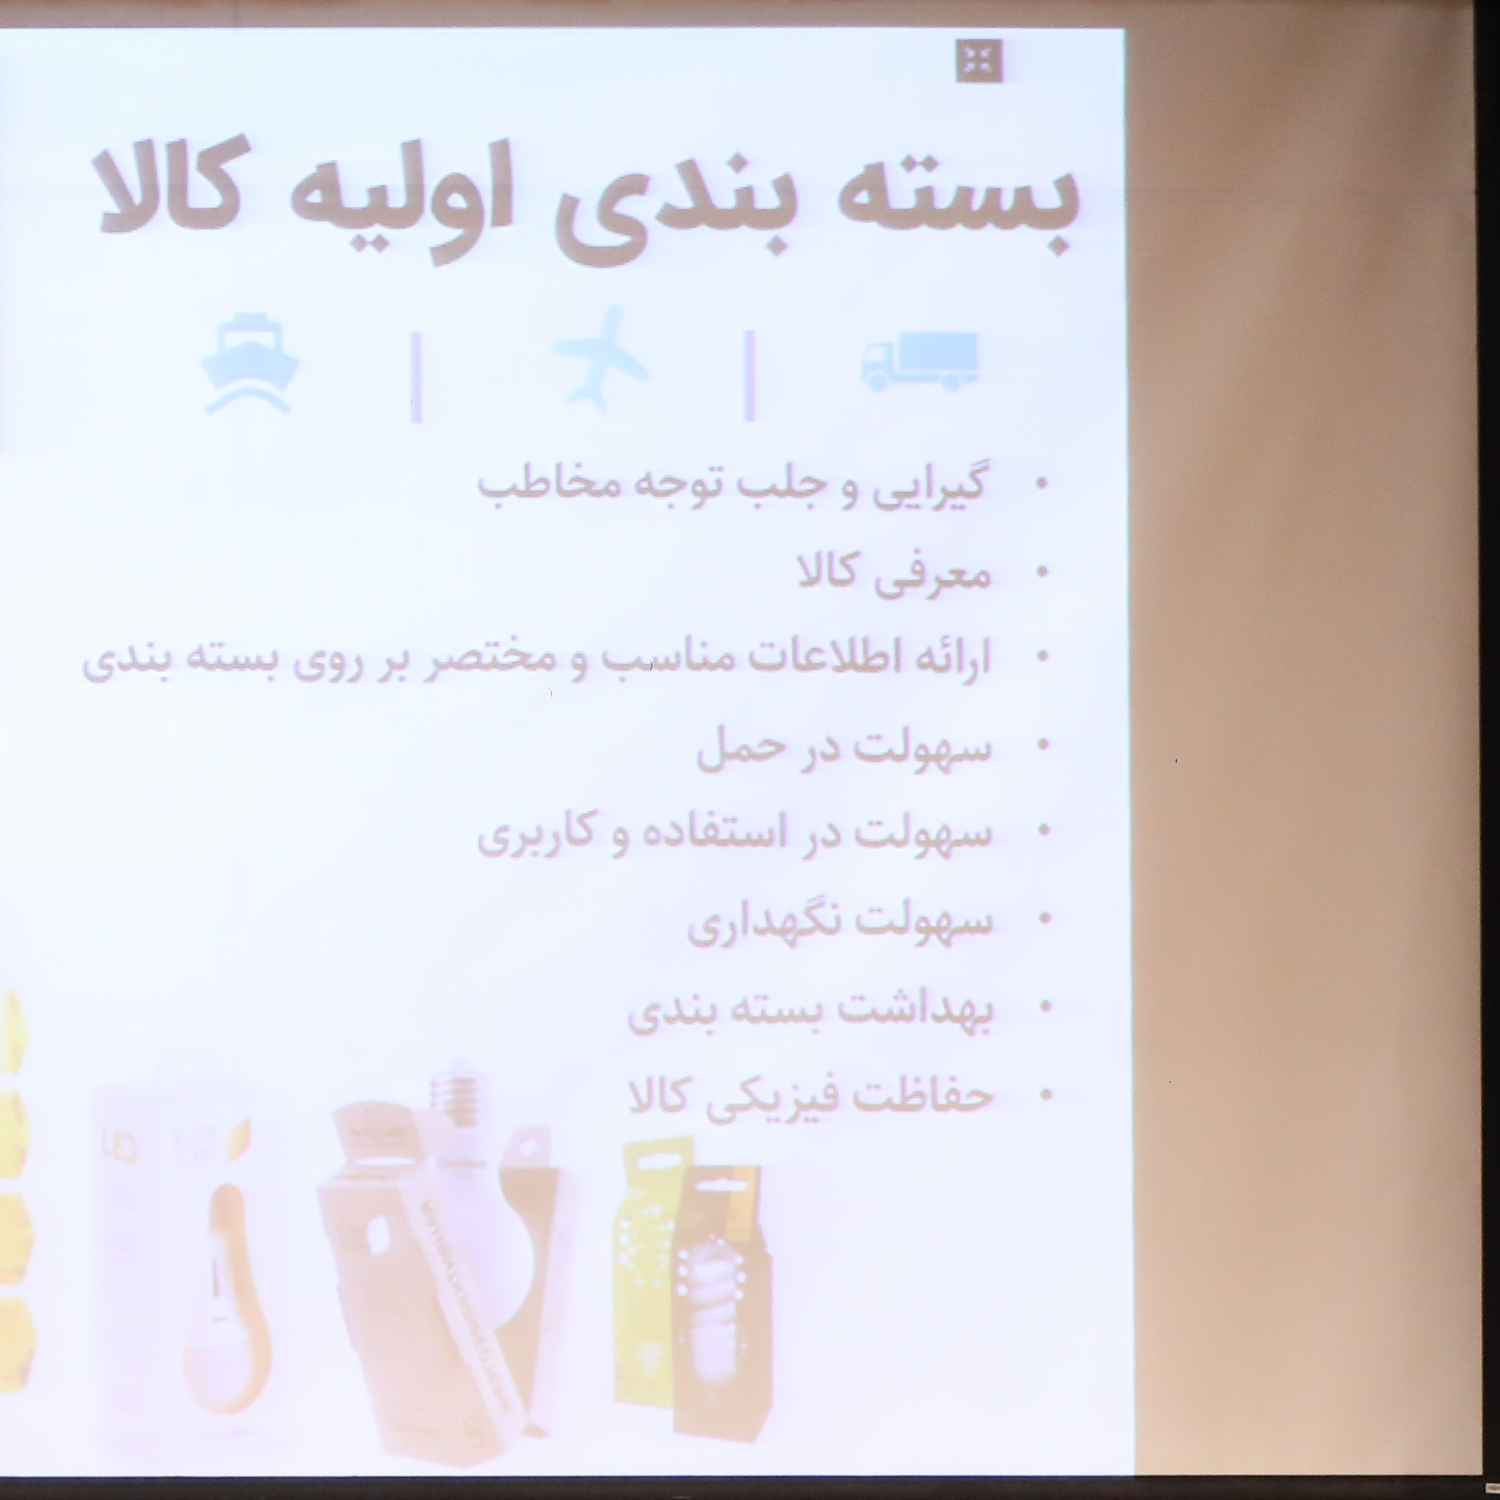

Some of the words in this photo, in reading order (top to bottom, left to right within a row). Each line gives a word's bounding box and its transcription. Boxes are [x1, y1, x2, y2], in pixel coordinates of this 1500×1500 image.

[90, 132, 253, 235] کالا
[290, 137, 516, 269] اولیه
[838, 153, 1083, 257] بسته
[555, 151, 800, 270] بندی
[477, 461, 625, 511] مخاطب
[634, 465, 725, 512] توجه
[736, 461, 830, 512] جلب
[841, 479, 863, 512] و
[872, 457, 993, 513] گیرایی
[796, 549, 863, 590] کالا
[874, 547, 994, 602] معرفی
[82, 640, 174, 685] بندی
[186, 641, 280, 685] بسته
[292, 649, 365, 684] روی
[375, 649, 411, 686] بر
[422, 634, 559, 684] مختصر
[570, 651, 592, 685] و
[601, 634, 738, 684] مناسب
[748, 634, 904, 675] اطلاعات
[915, 634, 992, 687] ارائه
[696, 723, 789, 775] حمل
[800, 735, 843, 776] در
[853, 725, 994, 777] سهولت
[477, 810, 601, 861] کاربری
[612, 826, 631, 860] و
[643, 810, 789, 850] استفاده
[801, 822, 843, 862] در
[854, 811, 994, 862] سهولت
[687, 894, 843, 950] نگهداری
[855, 897, 996, 949] سهولت
[627, 990, 719, 1038] بندی
[731, 991, 825, 1037] بسته
[837, 985, 997, 1038] بهداشت
[628, 1075, 694, 1115] کالا
[706, 1071, 842, 1127] فیزیکی
[852, 1073, 996, 1115] حفاظت
